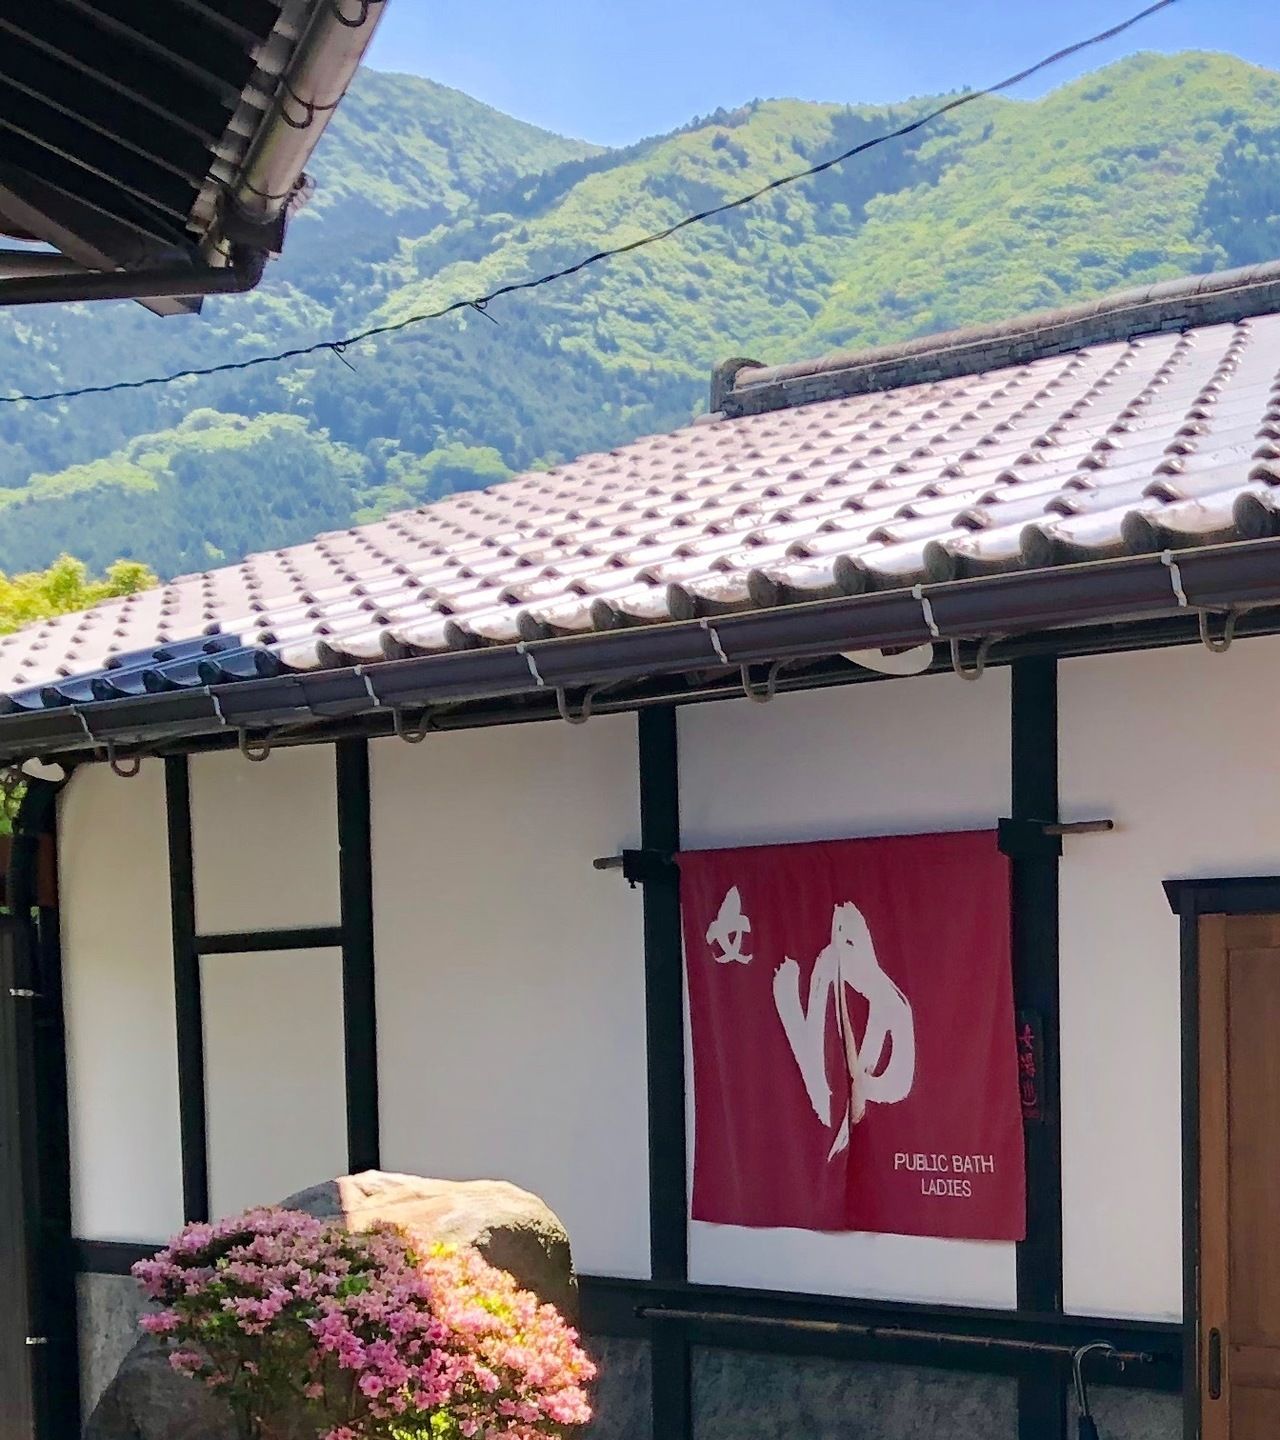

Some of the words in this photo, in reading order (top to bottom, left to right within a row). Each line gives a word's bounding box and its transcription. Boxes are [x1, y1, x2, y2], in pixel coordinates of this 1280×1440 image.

[705, 885, 753, 965] 女
[772, 900, 917, 1163] ゆ
[894, 1152, 949, 1172] PUBLIC
[952, 1154, 995, 1174] BATH
[921, 1178, 972, 1197] LADIES
